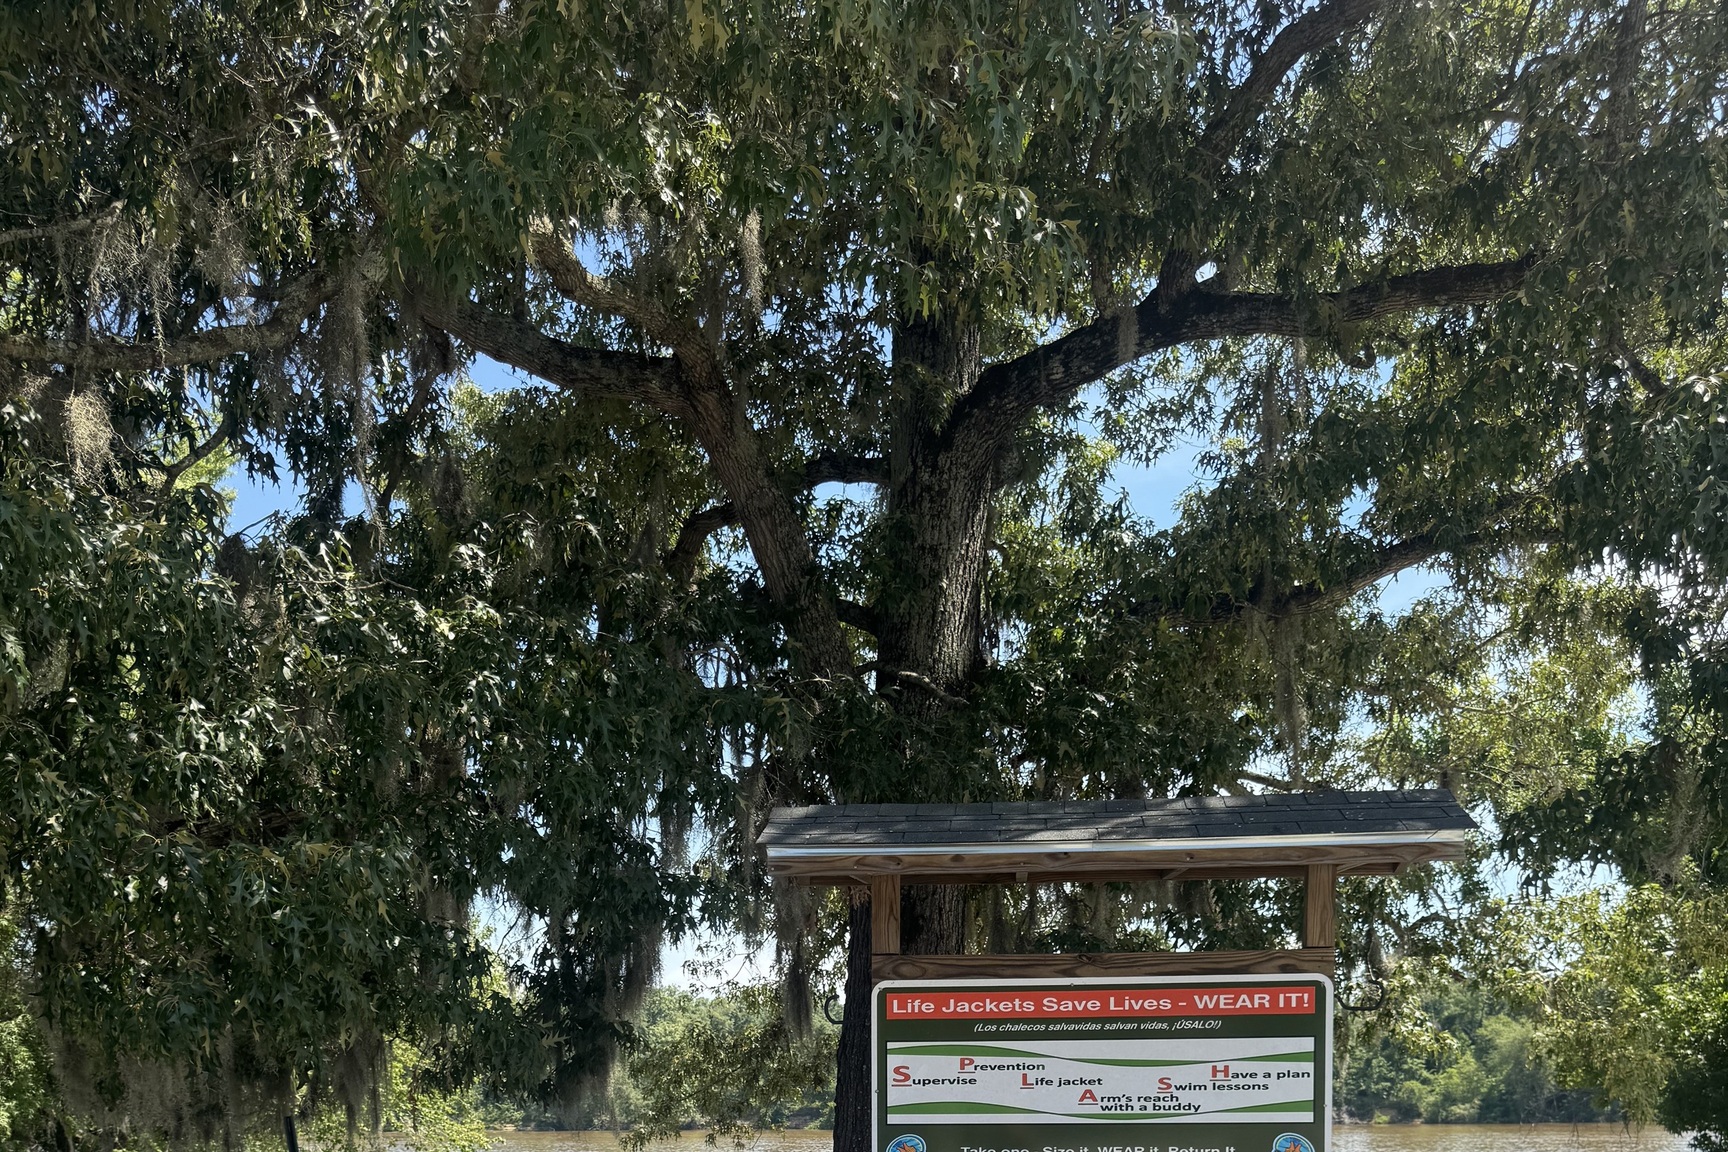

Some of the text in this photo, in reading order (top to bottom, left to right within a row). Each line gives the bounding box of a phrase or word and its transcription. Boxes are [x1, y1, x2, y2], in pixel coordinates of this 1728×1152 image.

[892, 999, 935, 1014] Life
[942, 998, 1035, 1013] Jackets
[1042, 997, 1101, 1012] Save
[1109, 996, 1172, 1011] Lives
[1194, 994, 1270, 1009] WEAR
[1279, 993, 1309, 1008] IT!
[974, 1020, 1222, 1033] (Los chalecos salvavidas salvan vidas, ¡ÚSALO!)
[959, 1057, 1046, 1071] Prevention
[892, 1065, 977, 1086] Supervise
[1211, 1065, 1311, 1081] Have a plan
[1020, 1073, 1103, 1088] Life jacket
[1157, 1077, 1269, 1091] Swim lessons
[1137, 1094, 1179, 1103] reach
[1100, 1103, 1134, 1112] with
[1152, 1102, 1201, 1114] buddy
